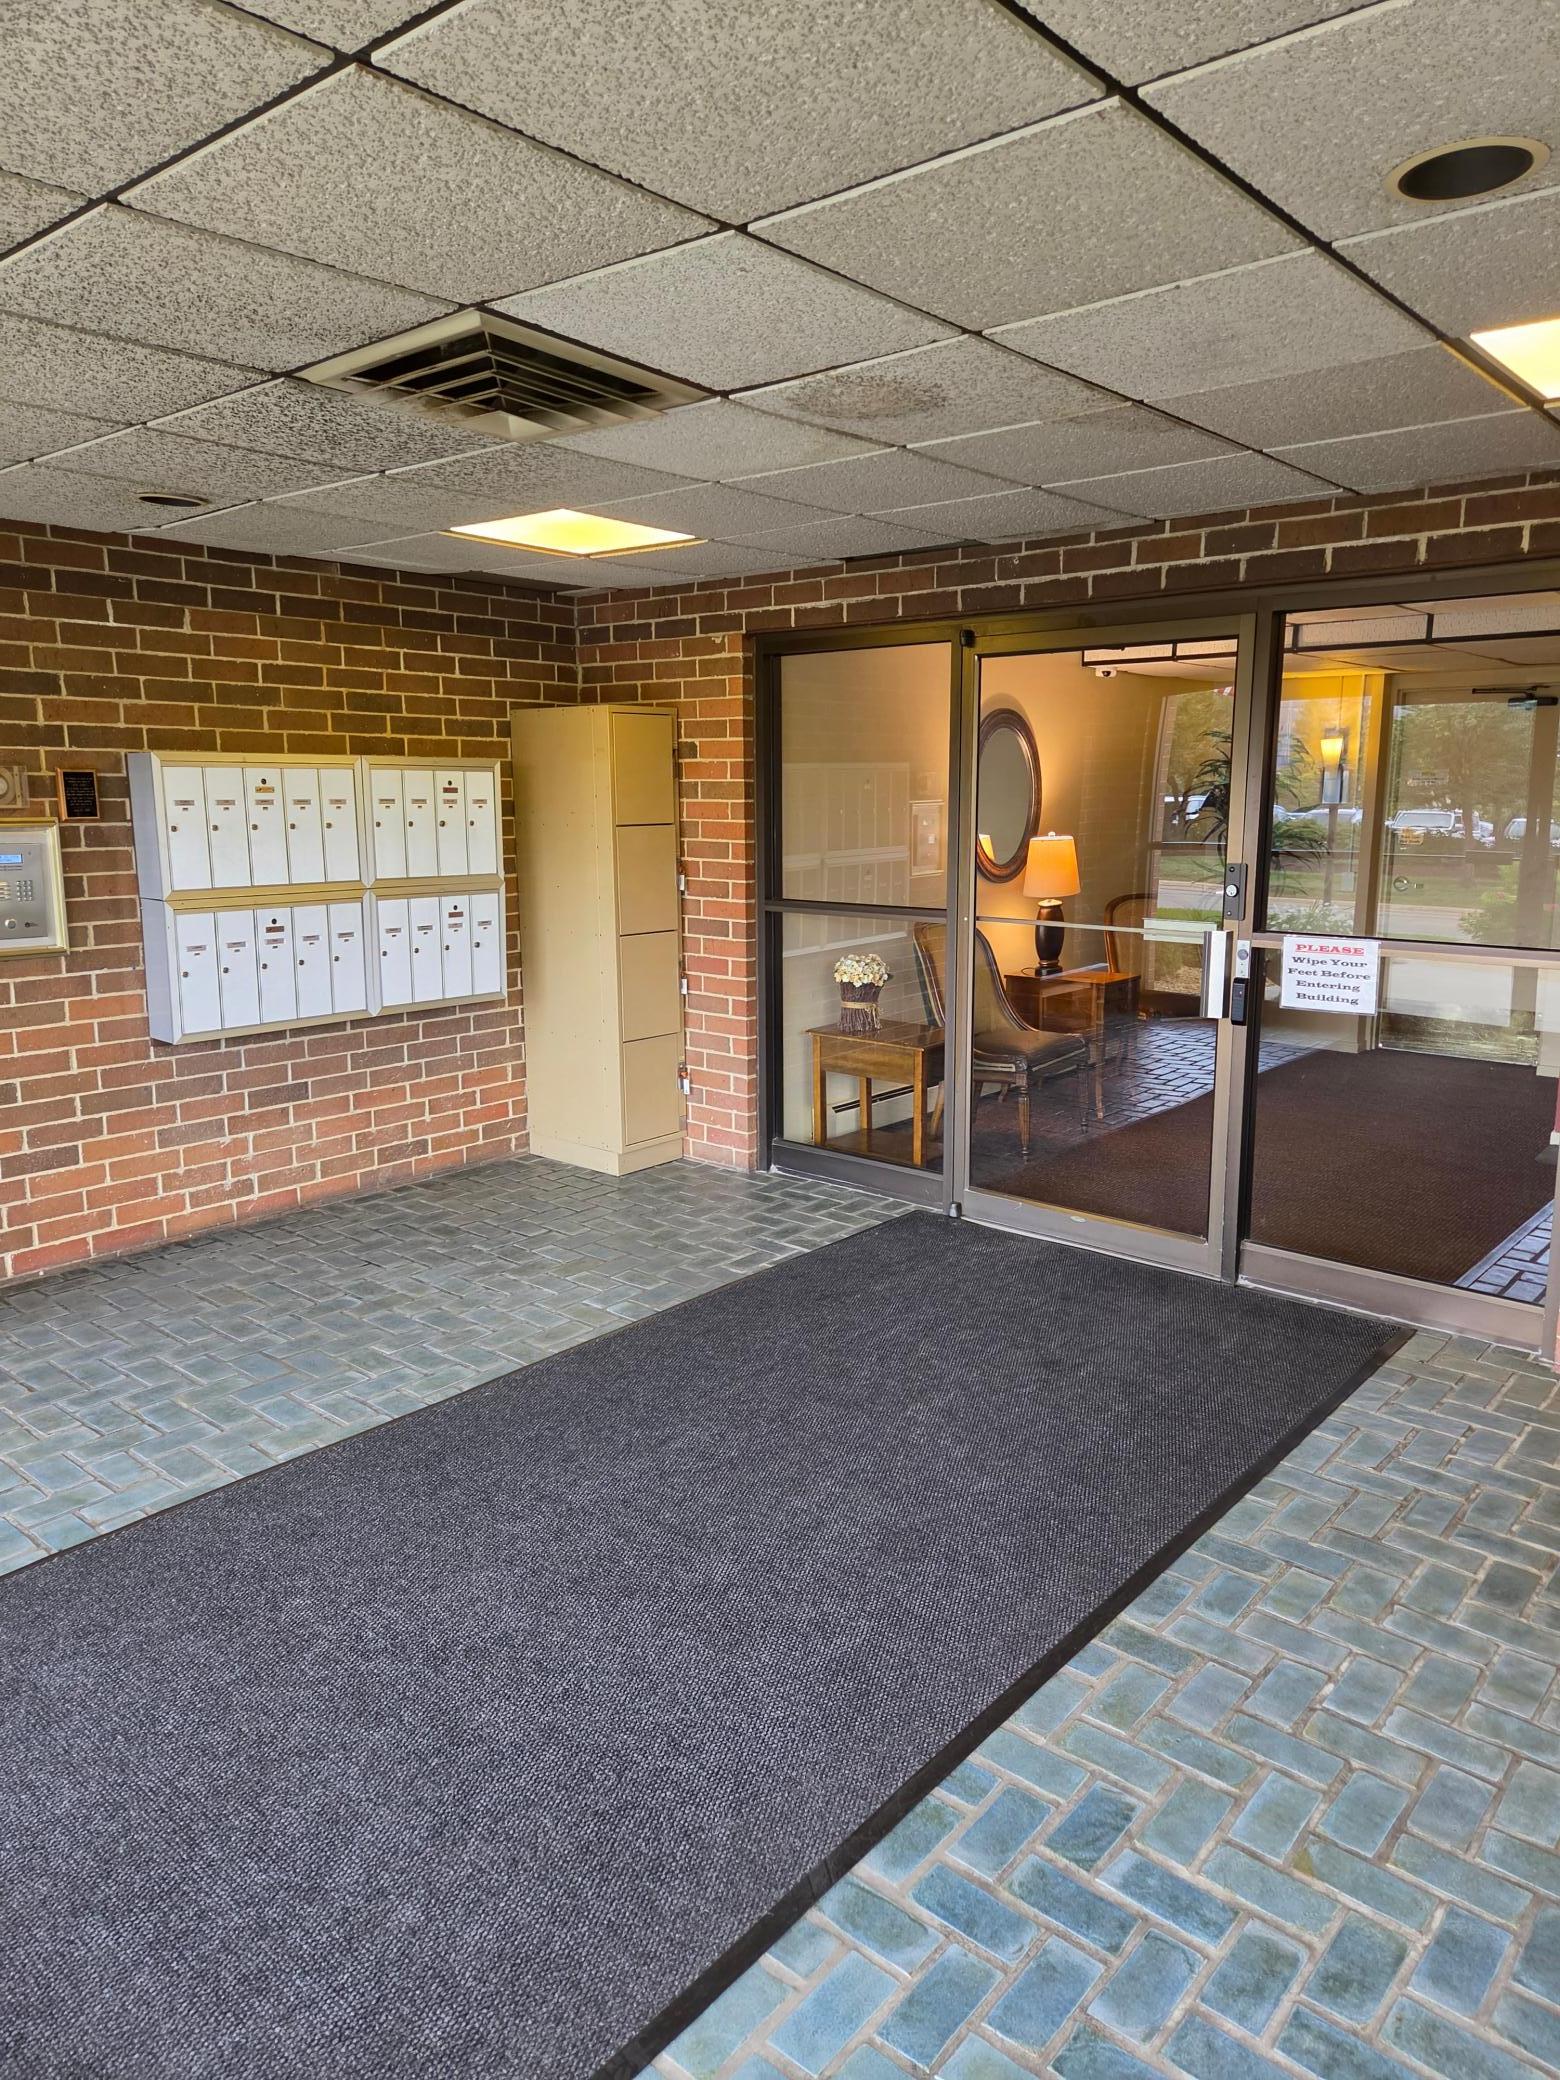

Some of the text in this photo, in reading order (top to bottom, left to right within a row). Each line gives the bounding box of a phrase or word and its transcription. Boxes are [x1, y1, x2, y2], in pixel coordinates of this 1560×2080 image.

[1296, 944, 1364, 955] PLEASE
[1292, 957, 1367, 967] Wipe Your
[1288, 968, 1371, 980] Feet Before
[1296, 980, 1360, 992] Entering
[1296, 992, 1359, 1005] Building
